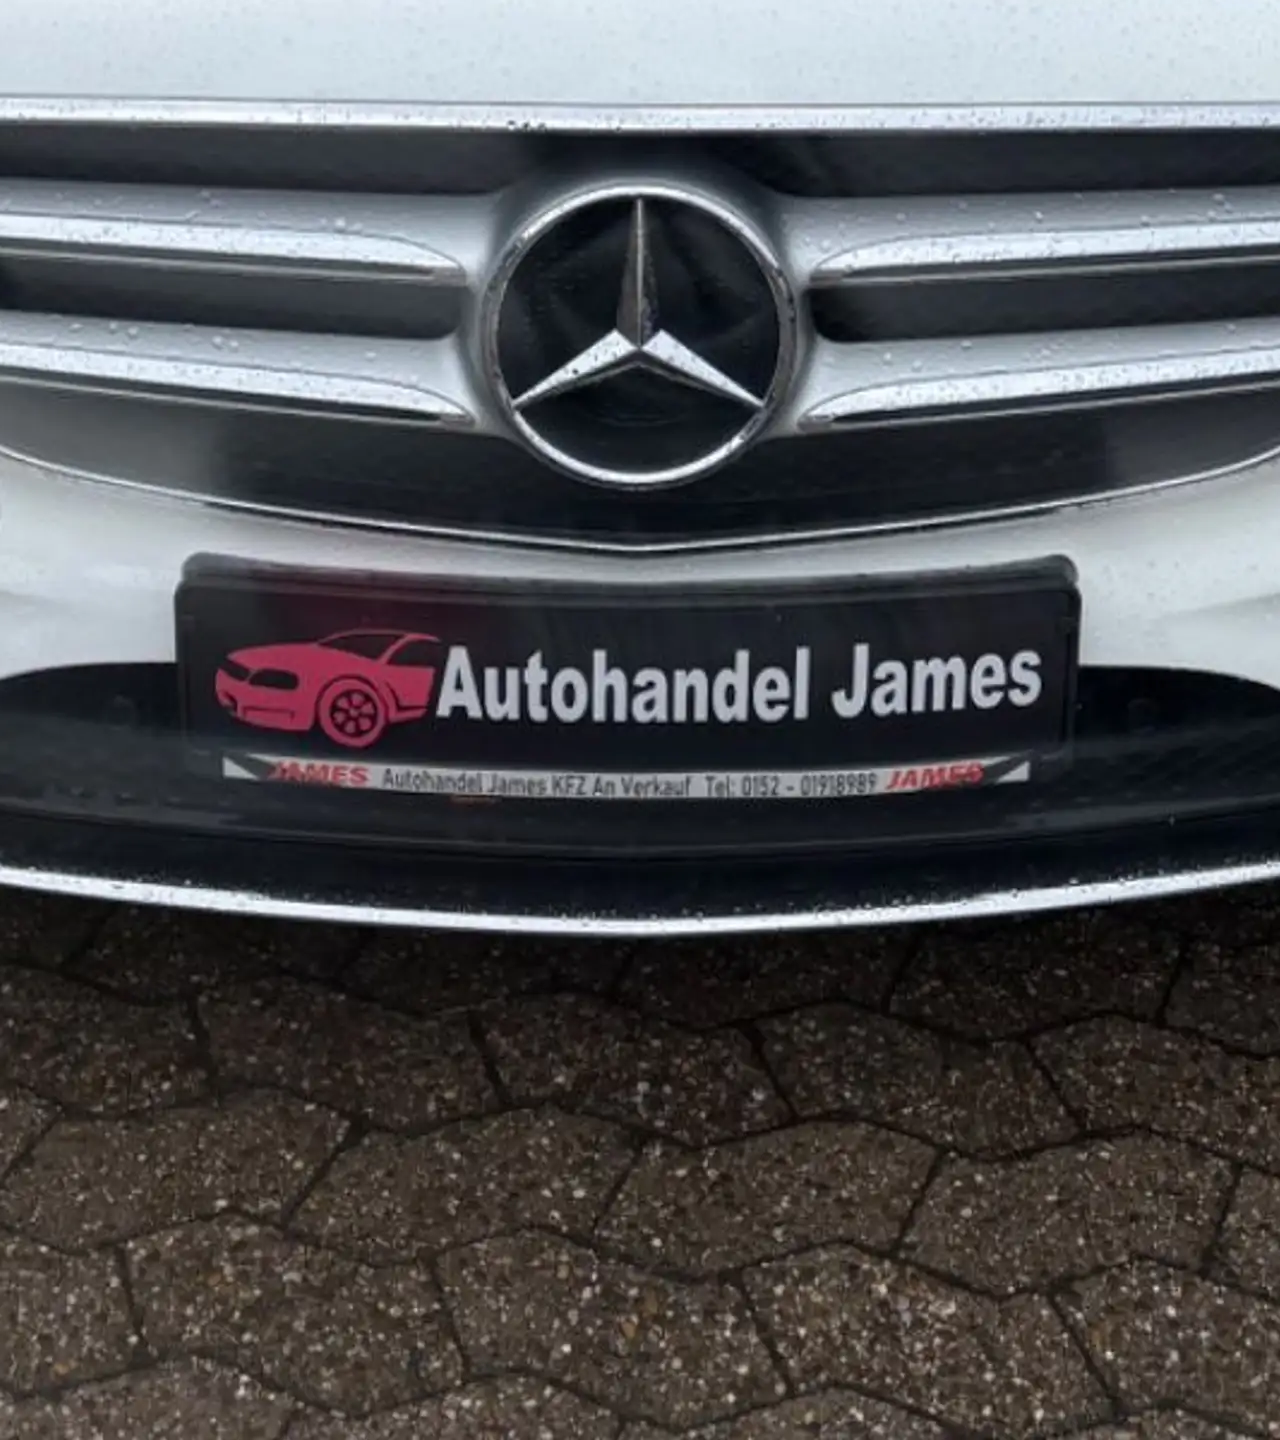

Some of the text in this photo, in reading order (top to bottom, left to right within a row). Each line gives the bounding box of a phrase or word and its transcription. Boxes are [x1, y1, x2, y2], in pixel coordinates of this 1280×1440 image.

[436, 643, 1042, 723] Autohandel James
[269, 761, 369, 787] JAMES
[382, 768, 483, 794] Autohandel
[488, 772, 547, 796] James
[552, 774, 586, 796] KFZ
[592, 774, 616, 796] An
[621, 775, 691, 797] Verkauf
[705, 775, 735, 797] Tel:
[741, 774, 779, 797] 0152
[885, 763, 984, 790] JAMES
